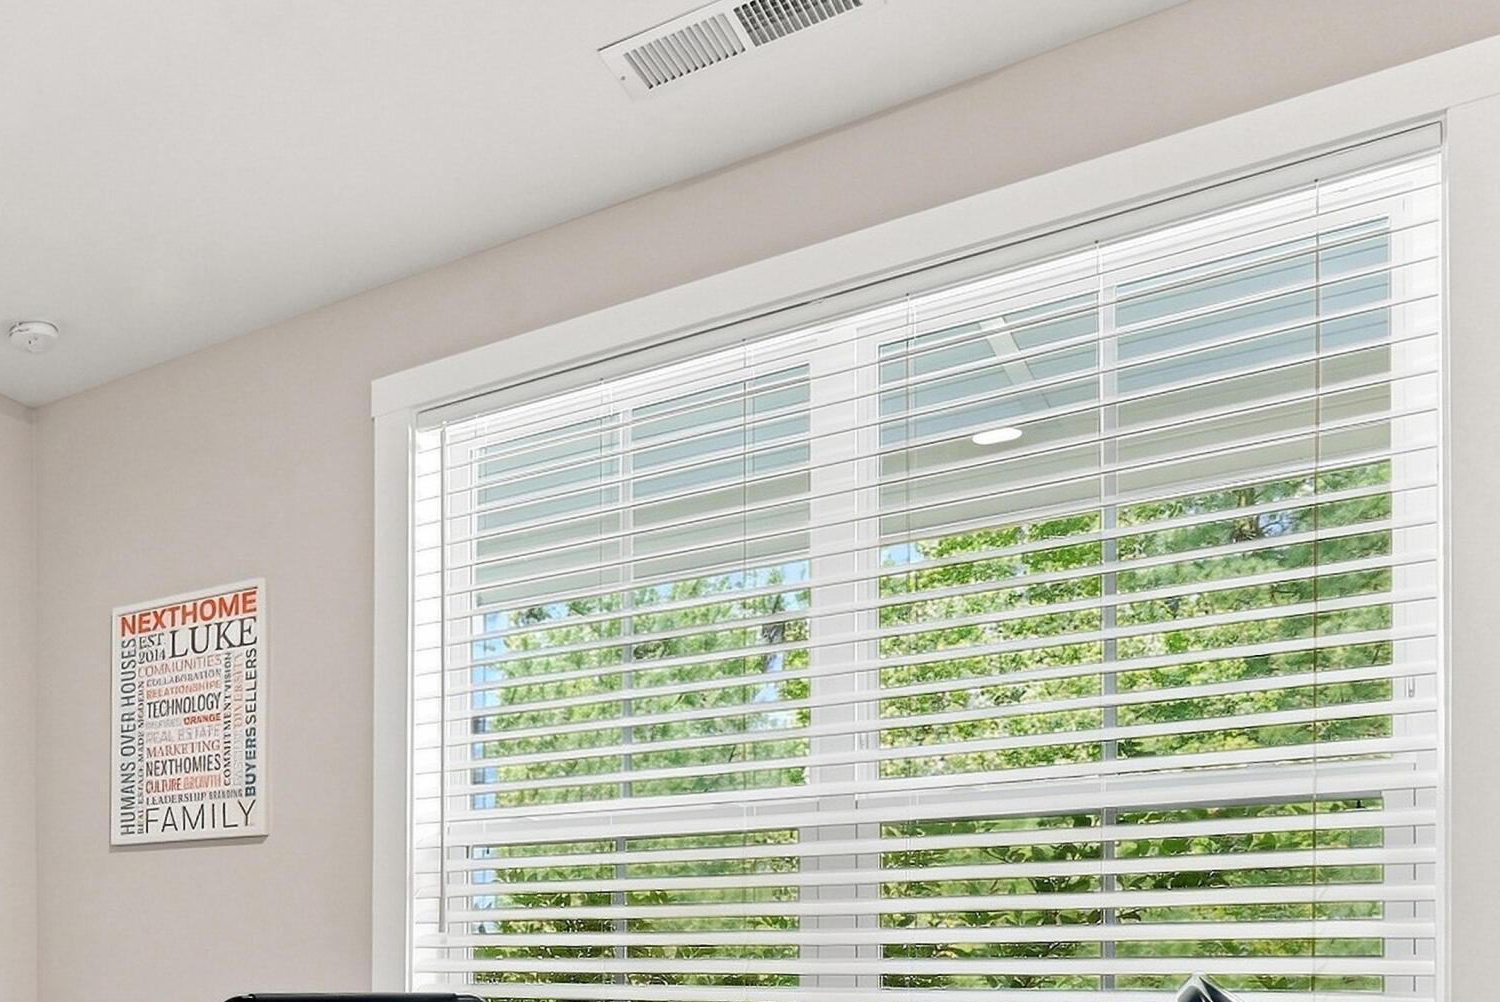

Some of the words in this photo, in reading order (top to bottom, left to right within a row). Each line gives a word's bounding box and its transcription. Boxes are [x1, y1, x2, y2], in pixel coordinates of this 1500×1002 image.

[120, 590, 258, 637] NEXTHOME
[169, 616, 258, 659] LUKE
[138, 649, 166, 664] 2014
[138, 654, 222, 678] COMMUNITIES
[120, 638, 136, 706] HOUSES
[146, 669, 222, 687] COLLABORATION
[224, 652, 232, 693] VISION
[146, 680, 221, 700] RELATIONSHIPS
[245, 648, 257, 725] SELLERS
[146, 692, 222, 718] TECHNOLOGY
[183, 713, 222, 726] ORANGE
[120, 711, 136, 757] OVER
[224, 695, 232, 786] COMMITMENT
[146, 739, 221, 758] MARKETING
[145, 753, 222, 777] NEXTHOMIES
[245, 727, 257, 797] BUYERS
[145, 777, 181, 794] CULTURE
[183, 774, 222, 790] GROWTH
[209, 788, 243, 799] BRANDING
[120, 762, 136, 835] HUMANS
[146, 791, 207, 806] LEADERSHIP
[145, 799, 257, 834] FAMILY
